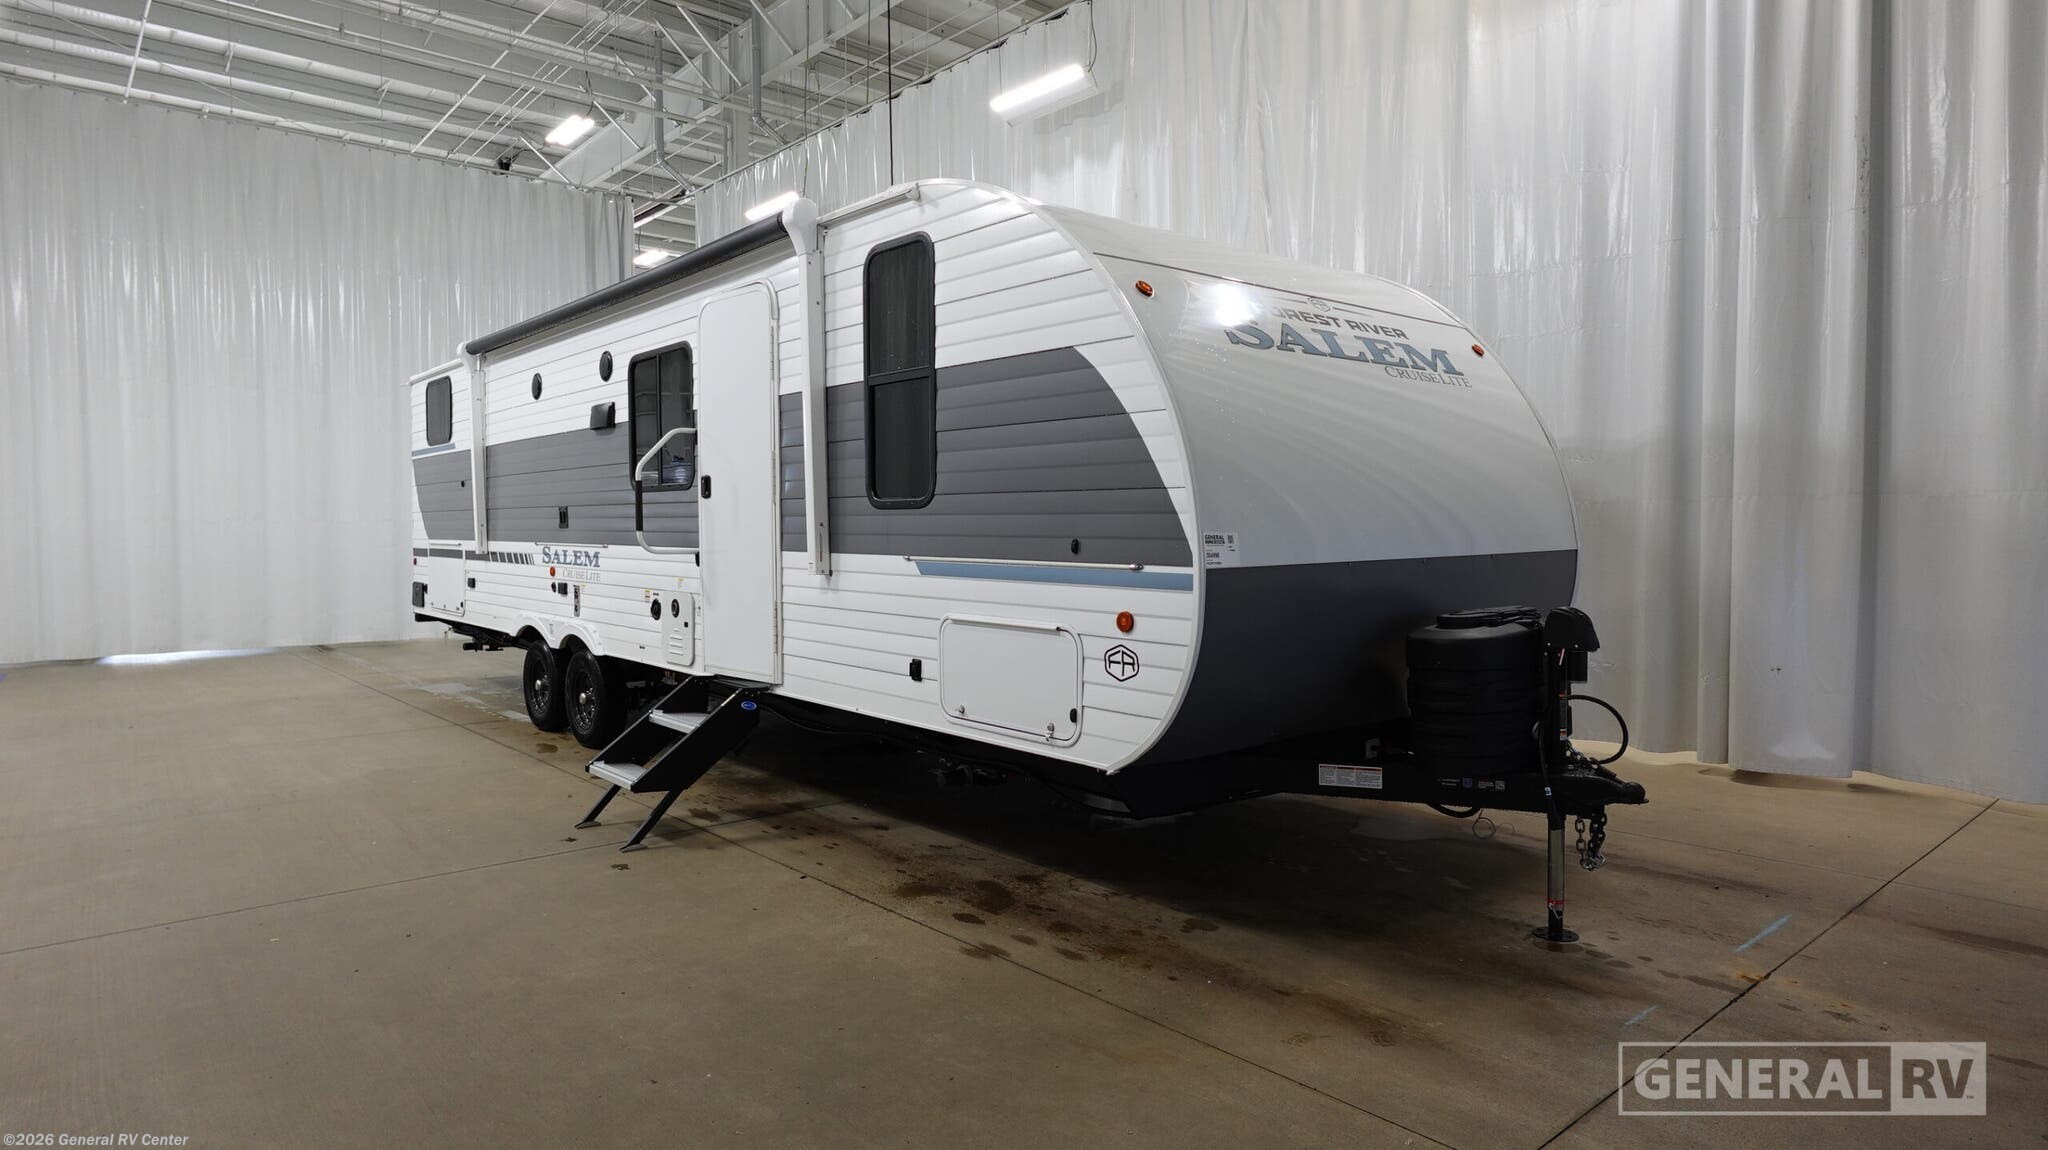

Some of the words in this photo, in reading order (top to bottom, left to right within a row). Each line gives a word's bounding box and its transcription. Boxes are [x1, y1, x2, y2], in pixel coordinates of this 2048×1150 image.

[1343, 316, 1409, 340] RIVER
[1224, 321, 1465, 377] SALEM
[542, 545, 601, 568] SALEM
